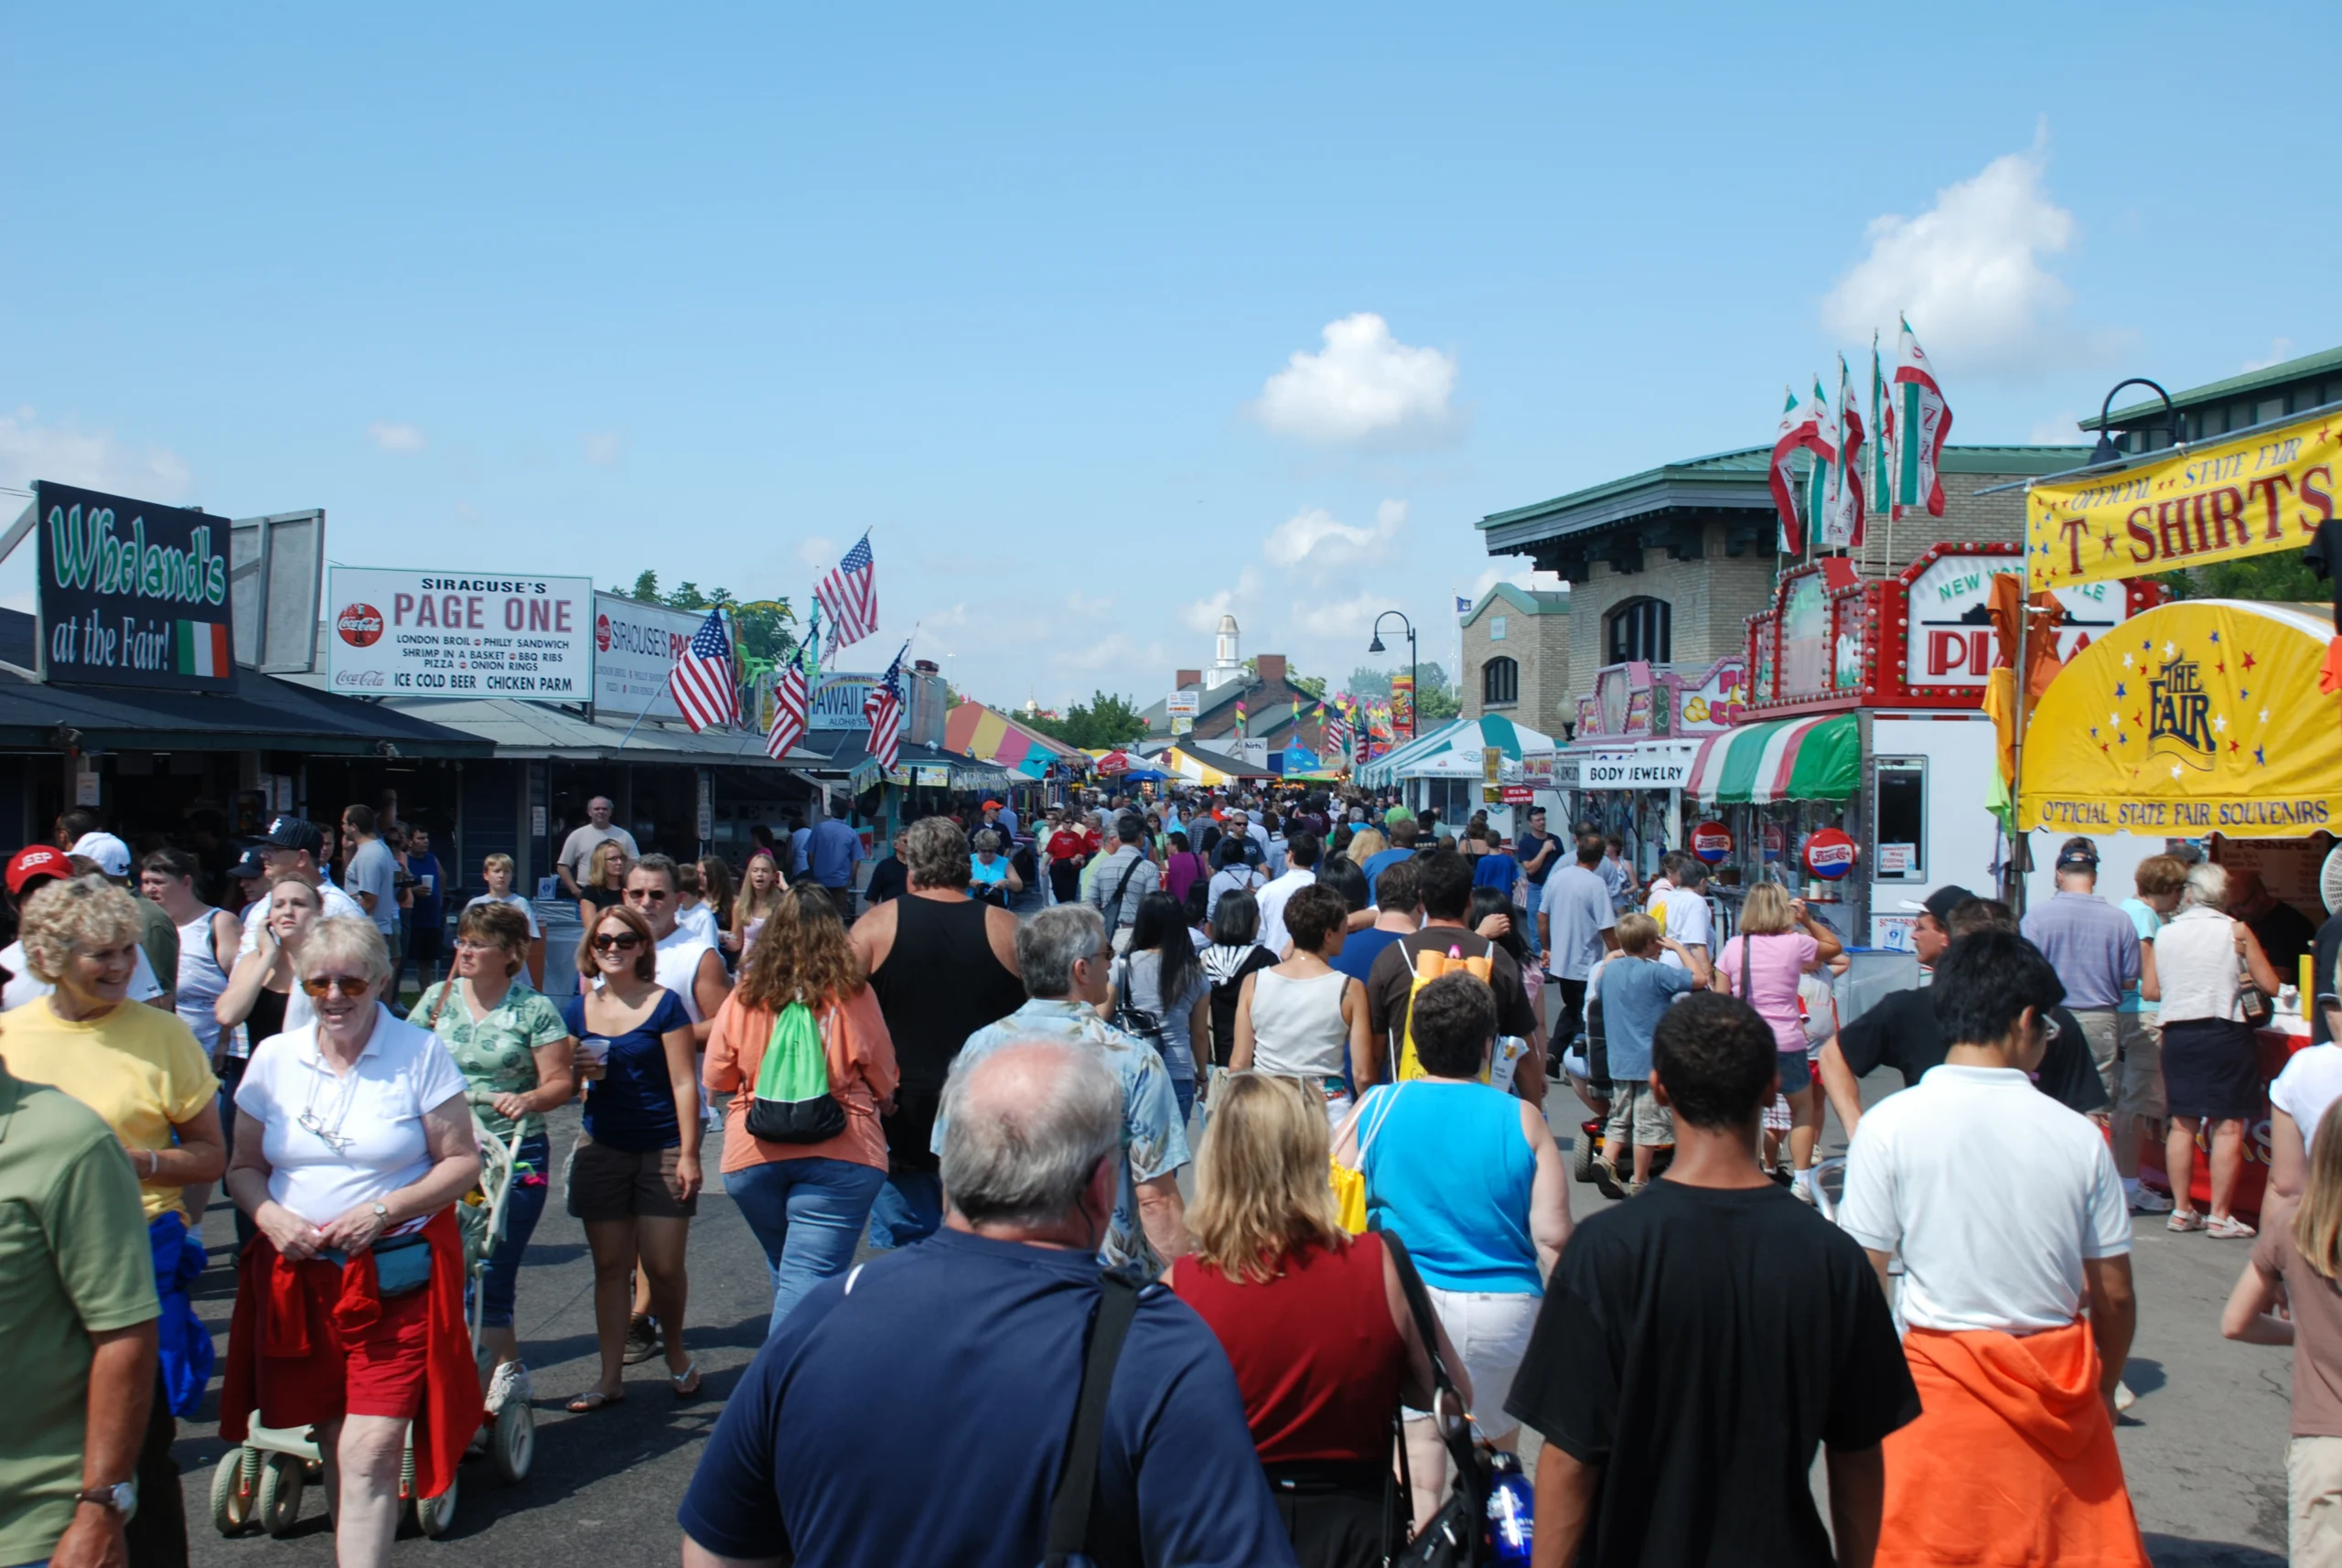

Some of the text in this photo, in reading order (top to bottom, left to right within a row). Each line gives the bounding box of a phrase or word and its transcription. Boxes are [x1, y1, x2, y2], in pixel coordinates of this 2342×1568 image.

[2070, 435, 2303, 511] OFFICIAL STATE FAIR
[2126, 461, 2335, 566] SHIRTS
[48, 503, 226, 606] Wheland's
[421, 577, 548, 595] SIRACUSE'S
[1938, 573, 1982, 603] NEW
[338, 616, 381, 632] Coca-Cola
[393, 592, 485, 630] PAGE
[504, 596, 573, 634] ONE
[52, 608, 170, 671] at the Fair!
[396, 634, 570, 650] LONDON BROIL PHILLY SANDWICH
[403, 648, 564, 662] SHRIMP IN A BASKET BBQ RIBS
[424, 659, 539, 671] PIZZA ONION RINGS
[394, 672, 573, 692] ICE COLD BEER CHICKEN PARM
[2156, 649, 2205, 694] THE
[2146, 673, 2218, 754] FAIR
[1590, 767, 1625, 780] BODY
[1628, 767, 1684, 781] JEWELRY
[2117, 803, 2167, 825] STATE
[2174, 803, 2210, 825] FAIR
[2218, 800, 2329, 825] SOUVENIRS
[18, 852, 53, 870] JEEP
